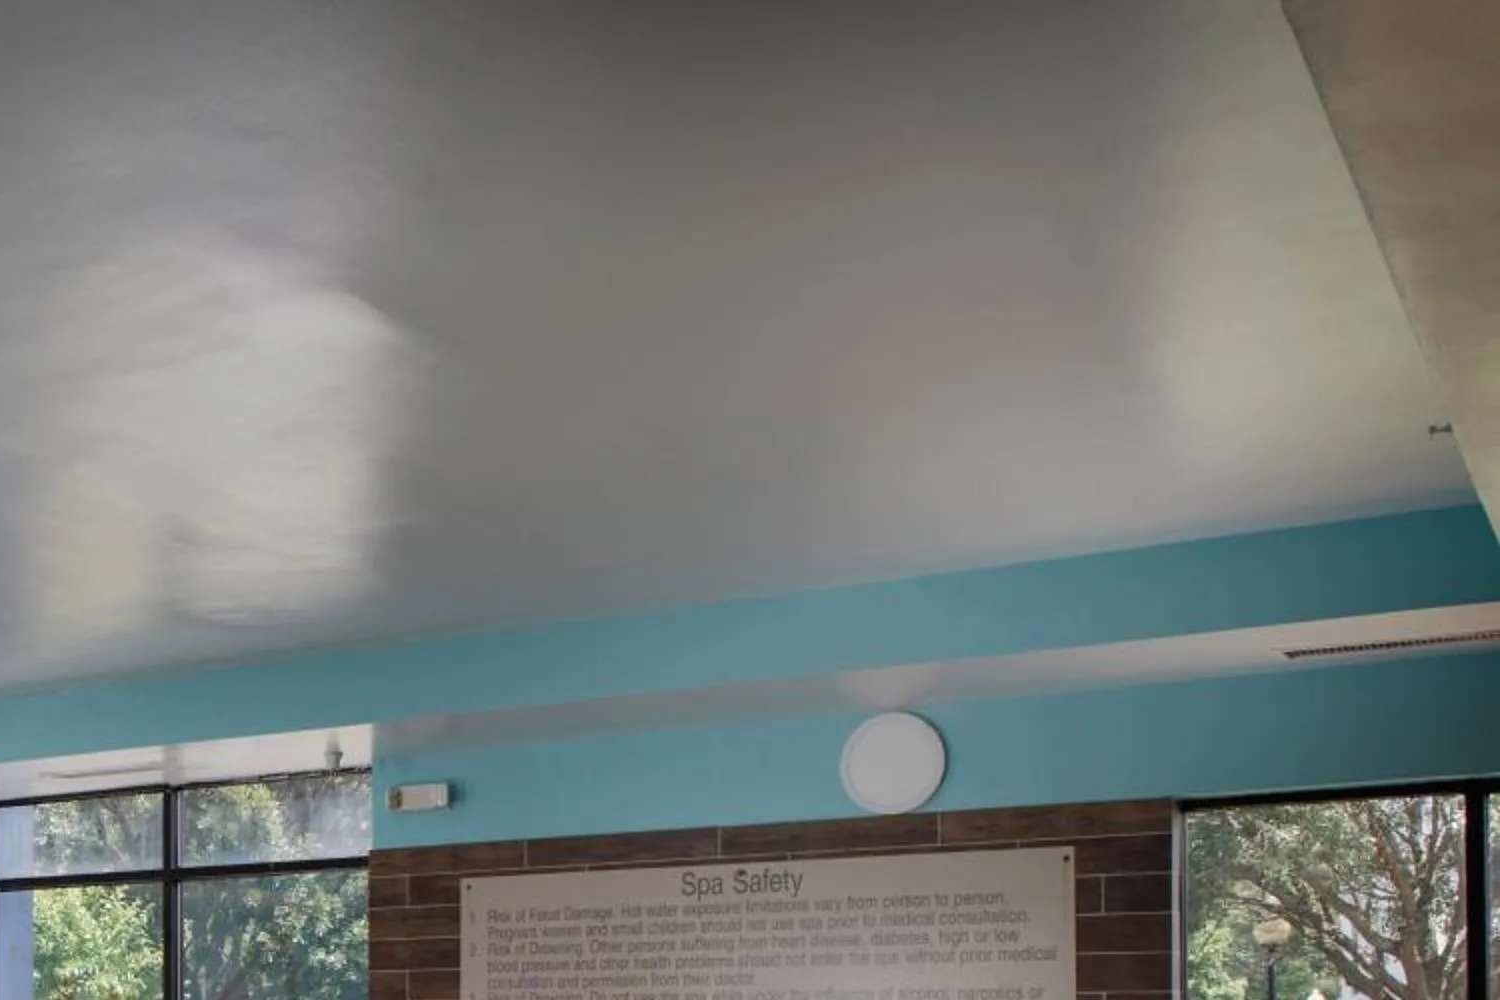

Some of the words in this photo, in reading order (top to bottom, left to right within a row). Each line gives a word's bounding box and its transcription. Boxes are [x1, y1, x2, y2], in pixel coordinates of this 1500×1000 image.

[681, 871, 724, 900] Spa
[732, 867, 804, 898] Safety
[621, 906, 642, 918] Hot
[847, 896, 878, 909] from
[935, 893, 949, 906] to
[585, 925, 609, 936] and
[827, 916, 858, 930] prior
[589, 939, 622, 952] Other
[994, 928, 1020, 942] low
[600, 957, 630, 970] other
